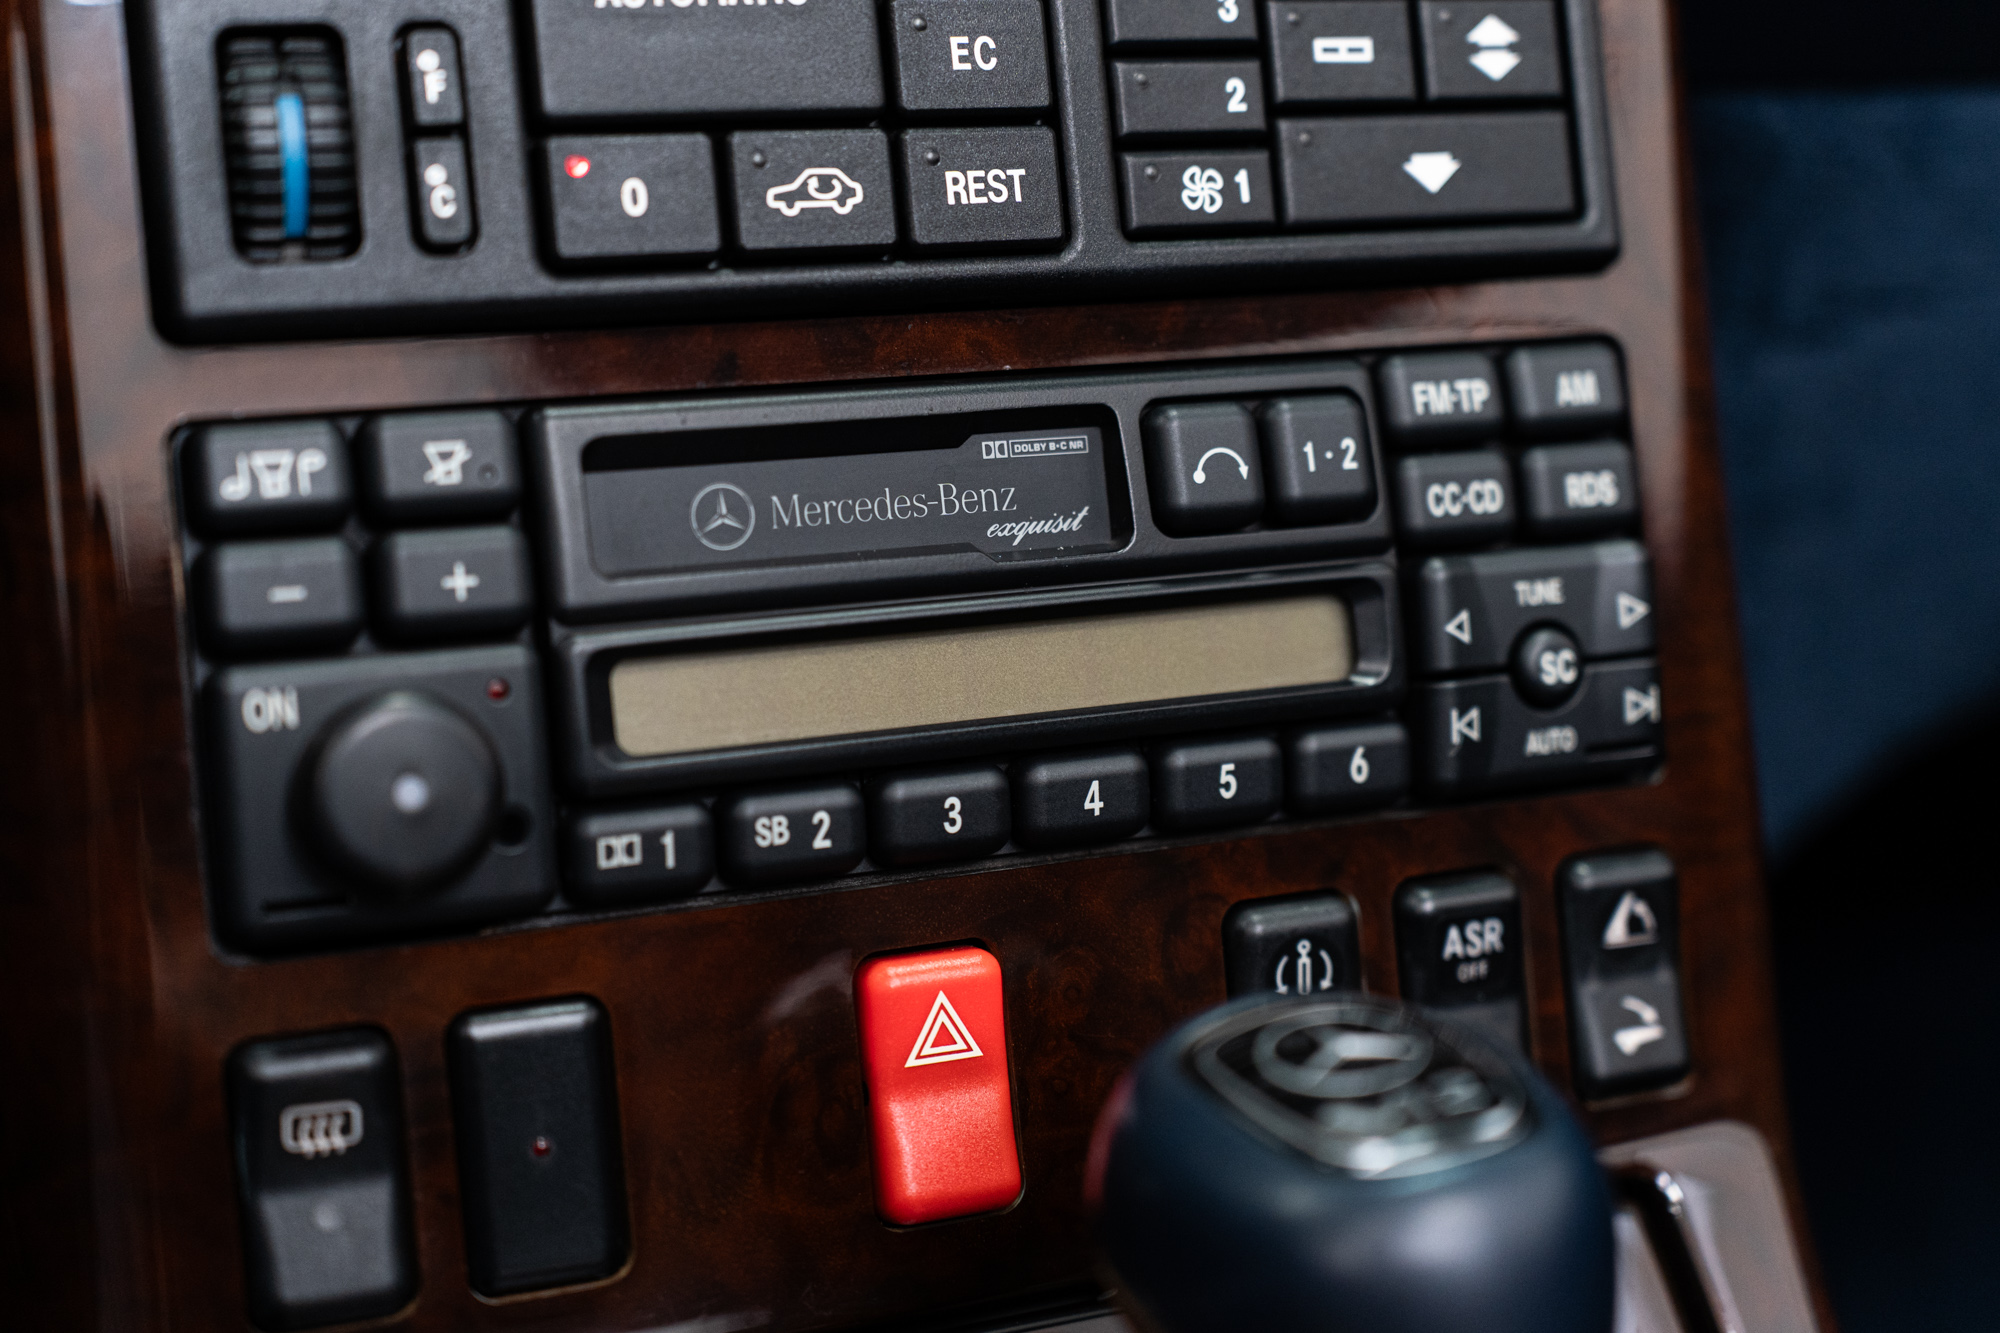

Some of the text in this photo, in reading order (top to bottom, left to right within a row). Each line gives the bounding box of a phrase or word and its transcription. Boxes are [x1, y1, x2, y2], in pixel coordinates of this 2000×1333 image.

[949, 36, 998, 71] EC
[1225, 77, 1248, 113] 2
[944, 169, 1026, 206] REST
[1234, 168, 1251, 204] 1
[1556, 371, 1599, 407] AM
[1014, 443, 1046, 453] DOLBY
[1069, 440, 1084, 449] NR
[771, 482, 1017, 529] Mercedes-Benz
[1564, 470, 1620, 508] RDS
[987, 506, 1089, 546] exquisit
[1514, 577, 1564, 606] TUNE
[1539, 649, 1579, 686] SC
[241, 687, 300, 733] ON
[1526, 727, 1578, 757] AUTO
[1219, 763, 1238, 799] 5
[1349, 746, 1370, 784] 6
[942, 796, 963, 835] 3
[1083, 780, 1104, 816] 4
[754, 810, 833, 850] SB 2
[660, 829, 676, 870] 1
[1442, 917, 1504, 961] ASR
[1457, 960, 1489, 983] OFF
